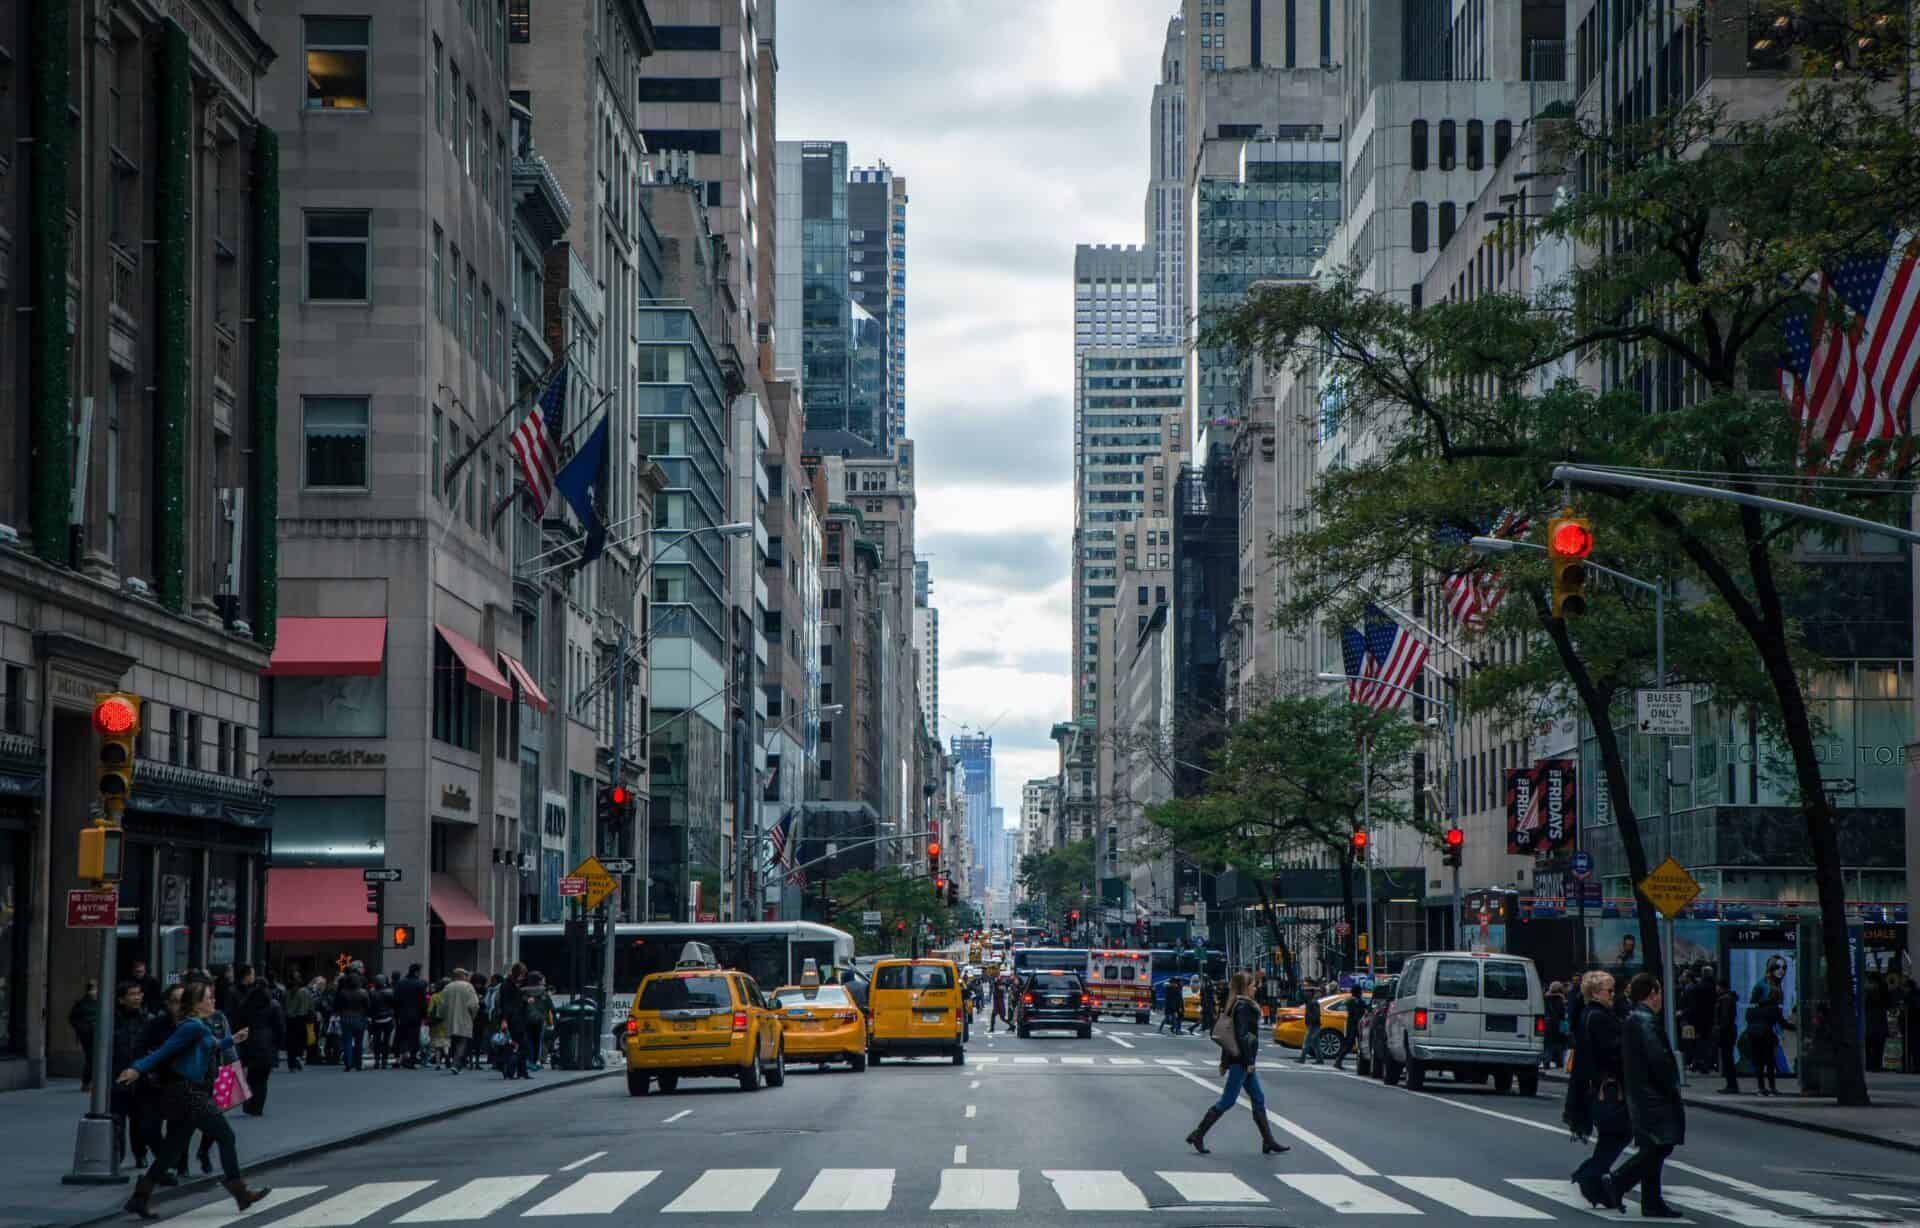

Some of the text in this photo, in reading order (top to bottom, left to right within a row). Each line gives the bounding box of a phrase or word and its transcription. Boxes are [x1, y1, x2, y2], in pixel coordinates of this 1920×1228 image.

[1647, 693, 1682, 702] BUSES
[1651, 709, 1678, 718] ONLY
[353, 748, 386, 764] Place
[1549, 777, 1562, 840] FRIDAYS
[76, 903, 108, 913] ANYTIME
